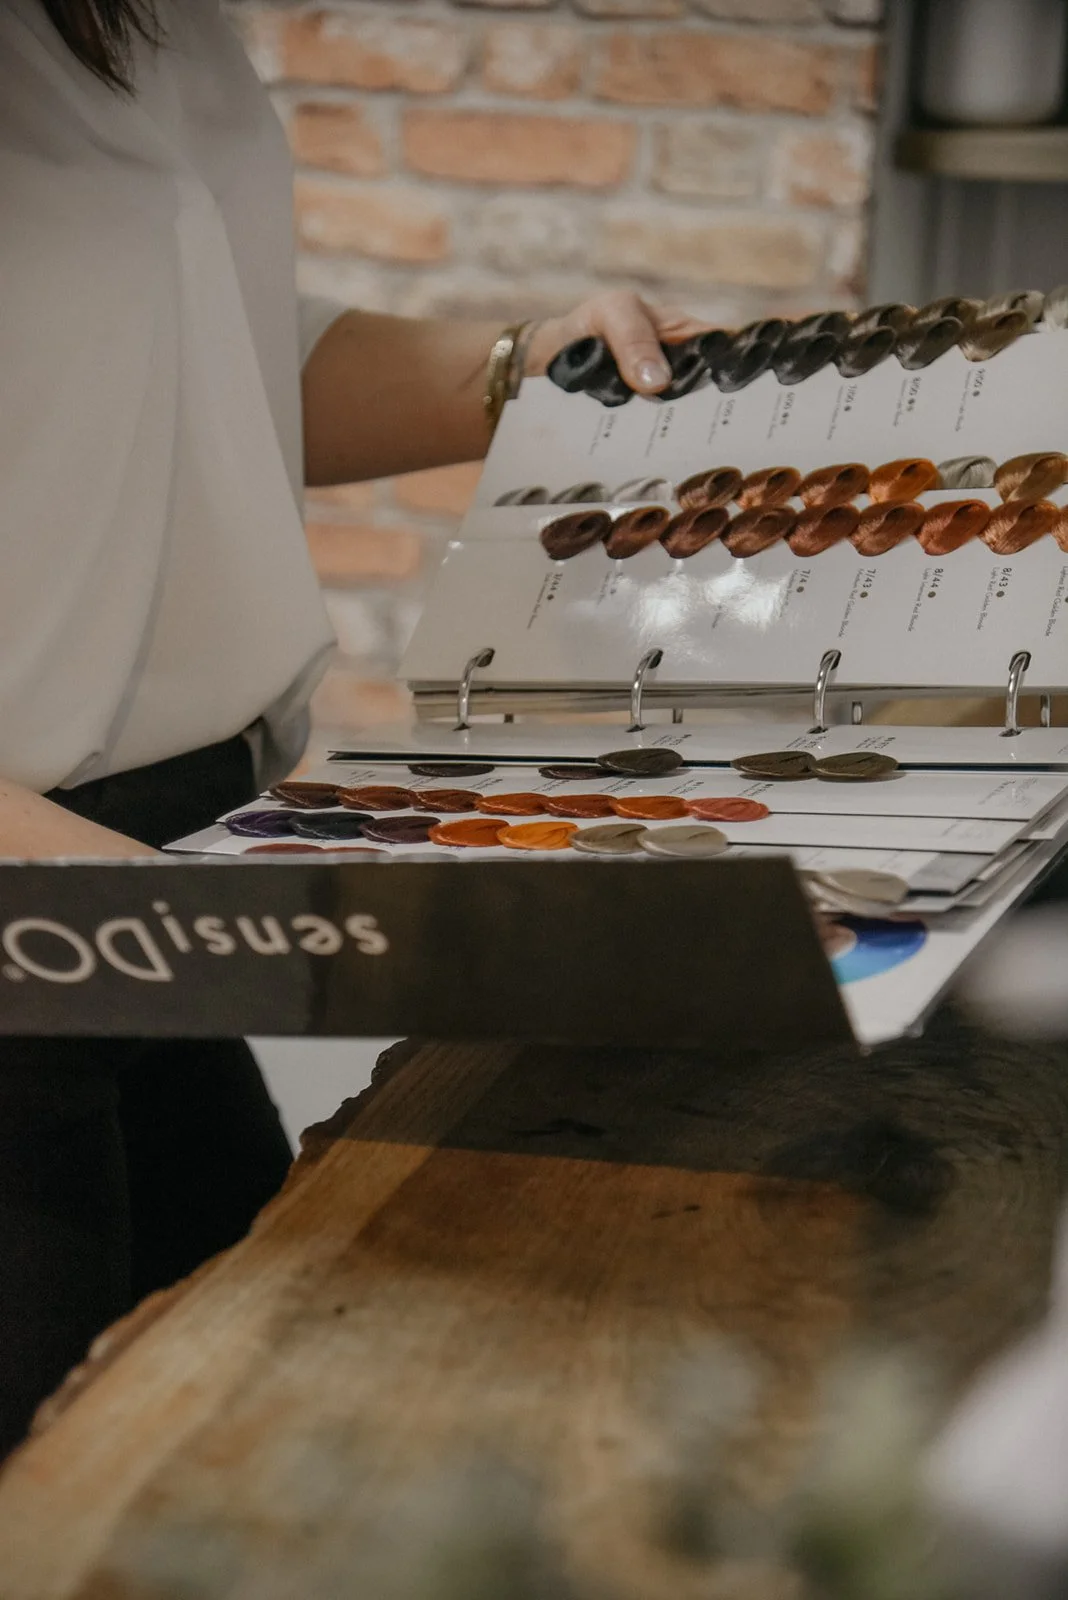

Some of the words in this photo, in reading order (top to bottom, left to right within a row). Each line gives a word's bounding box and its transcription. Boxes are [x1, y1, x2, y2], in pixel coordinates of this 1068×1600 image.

[799, 569, 811, 583] 7/4
[862, 569, 877, 589] 7/43
[930, 568, 944, 588] 8/44
[998, 567, 1013, 588] 8/43
